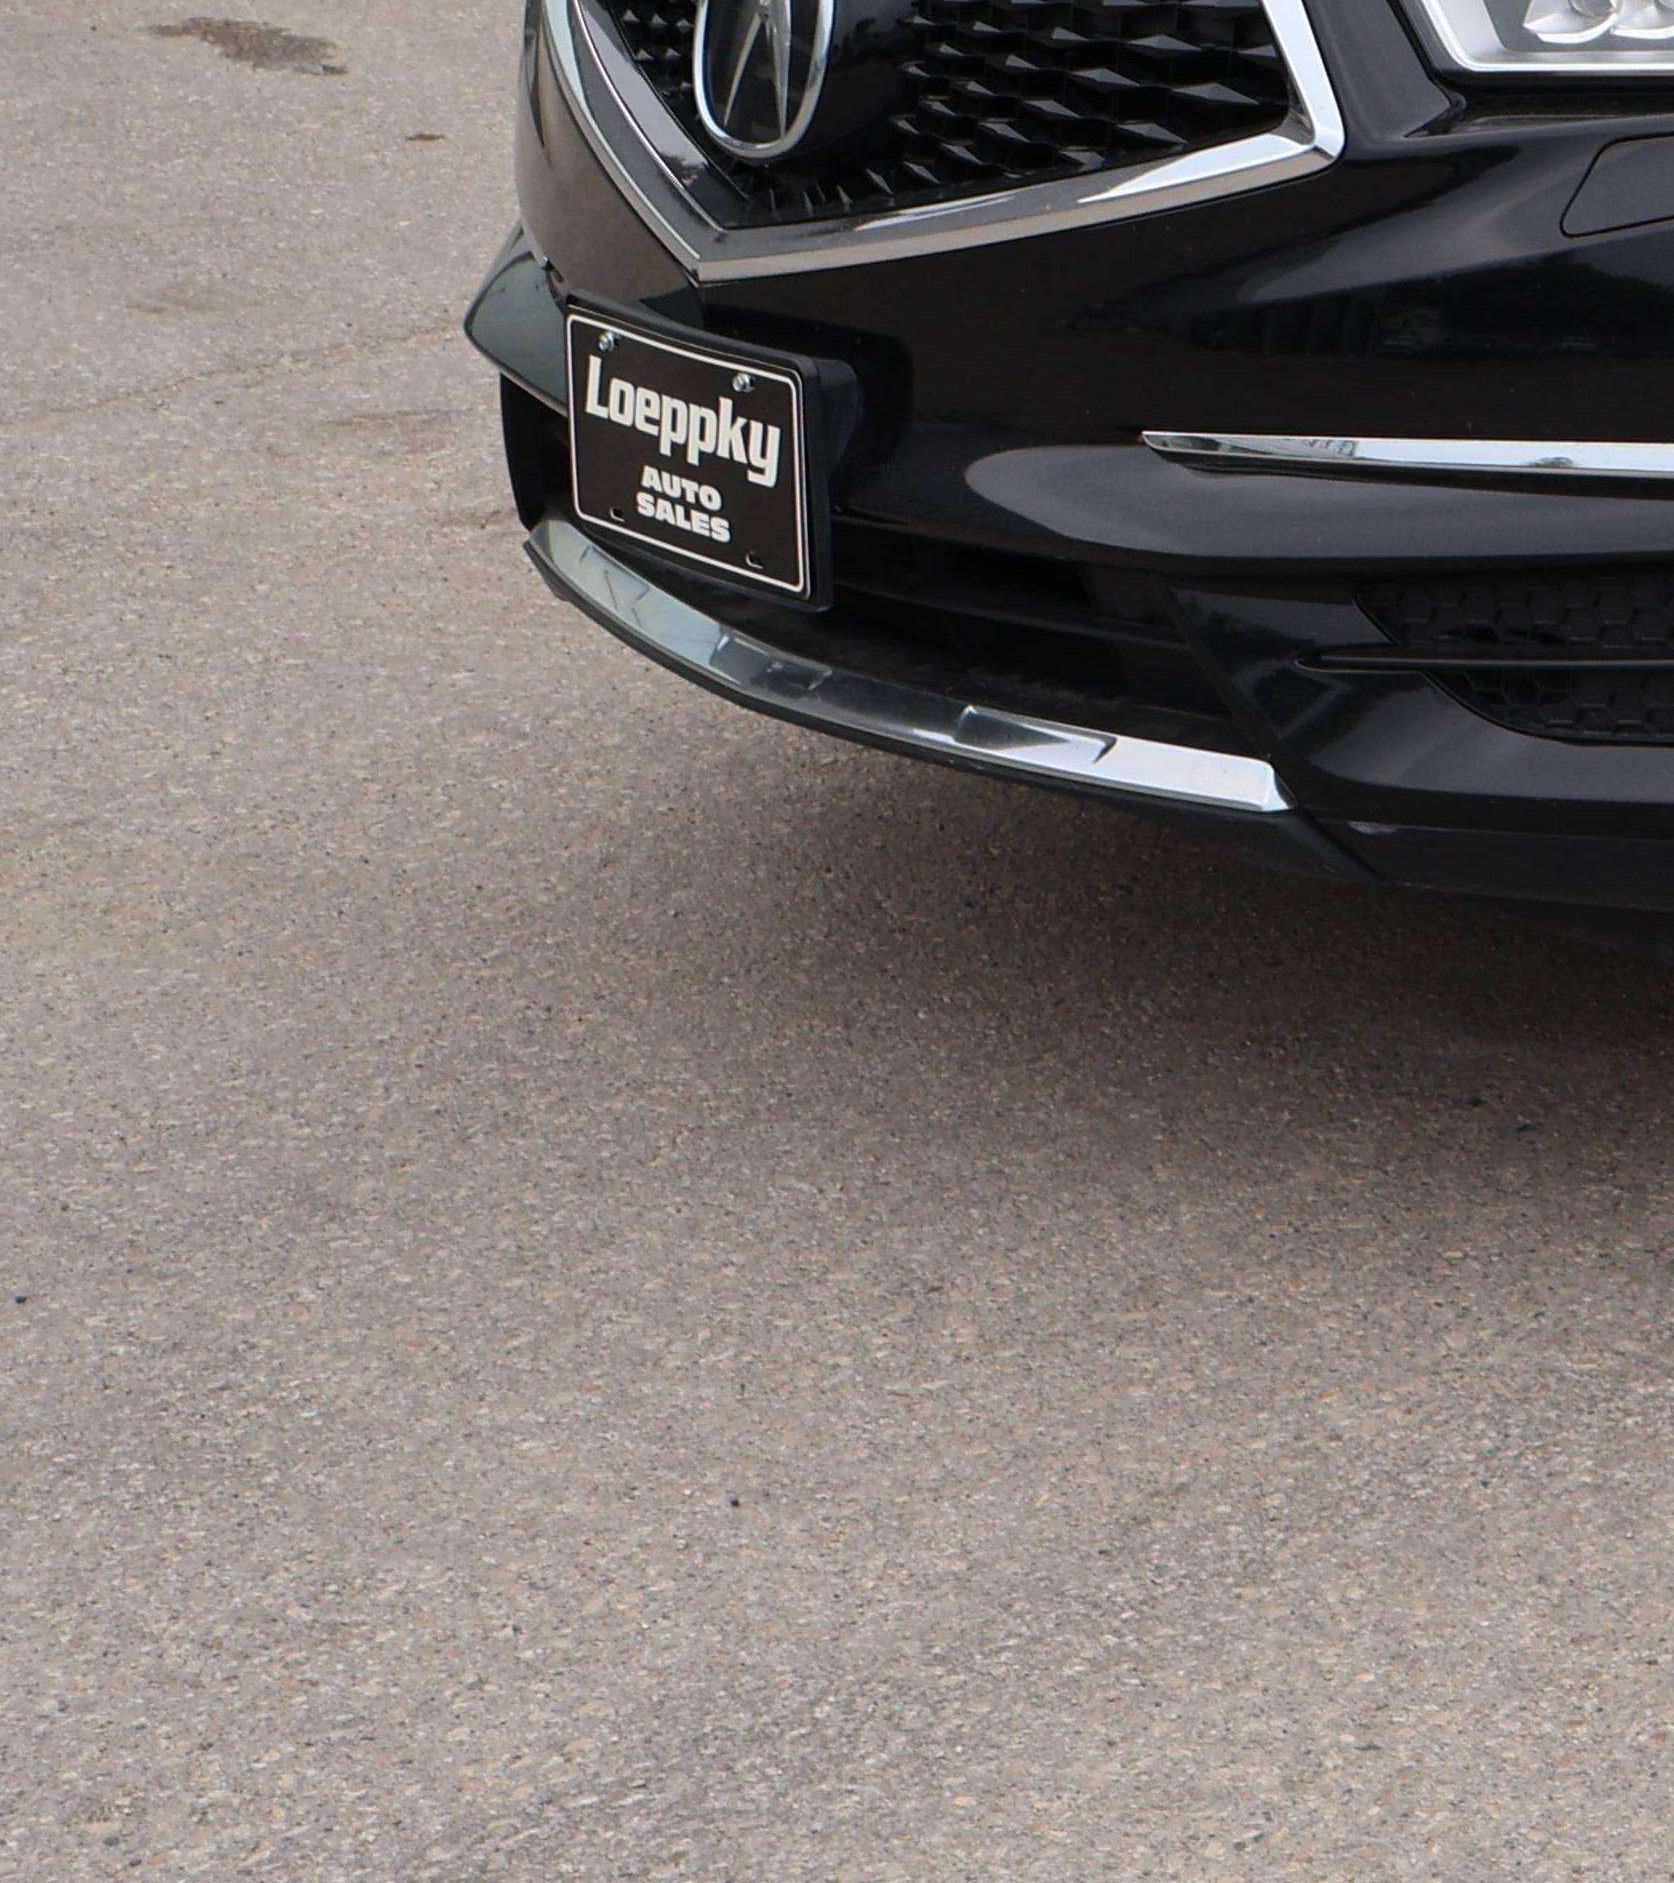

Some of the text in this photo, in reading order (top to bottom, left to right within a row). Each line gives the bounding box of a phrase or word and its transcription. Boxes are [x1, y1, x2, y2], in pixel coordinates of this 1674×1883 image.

[585, 354, 781, 489] Loeppky
[641, 465, 723, 512] AUTO
[636, 491, 732, 544] SALES
